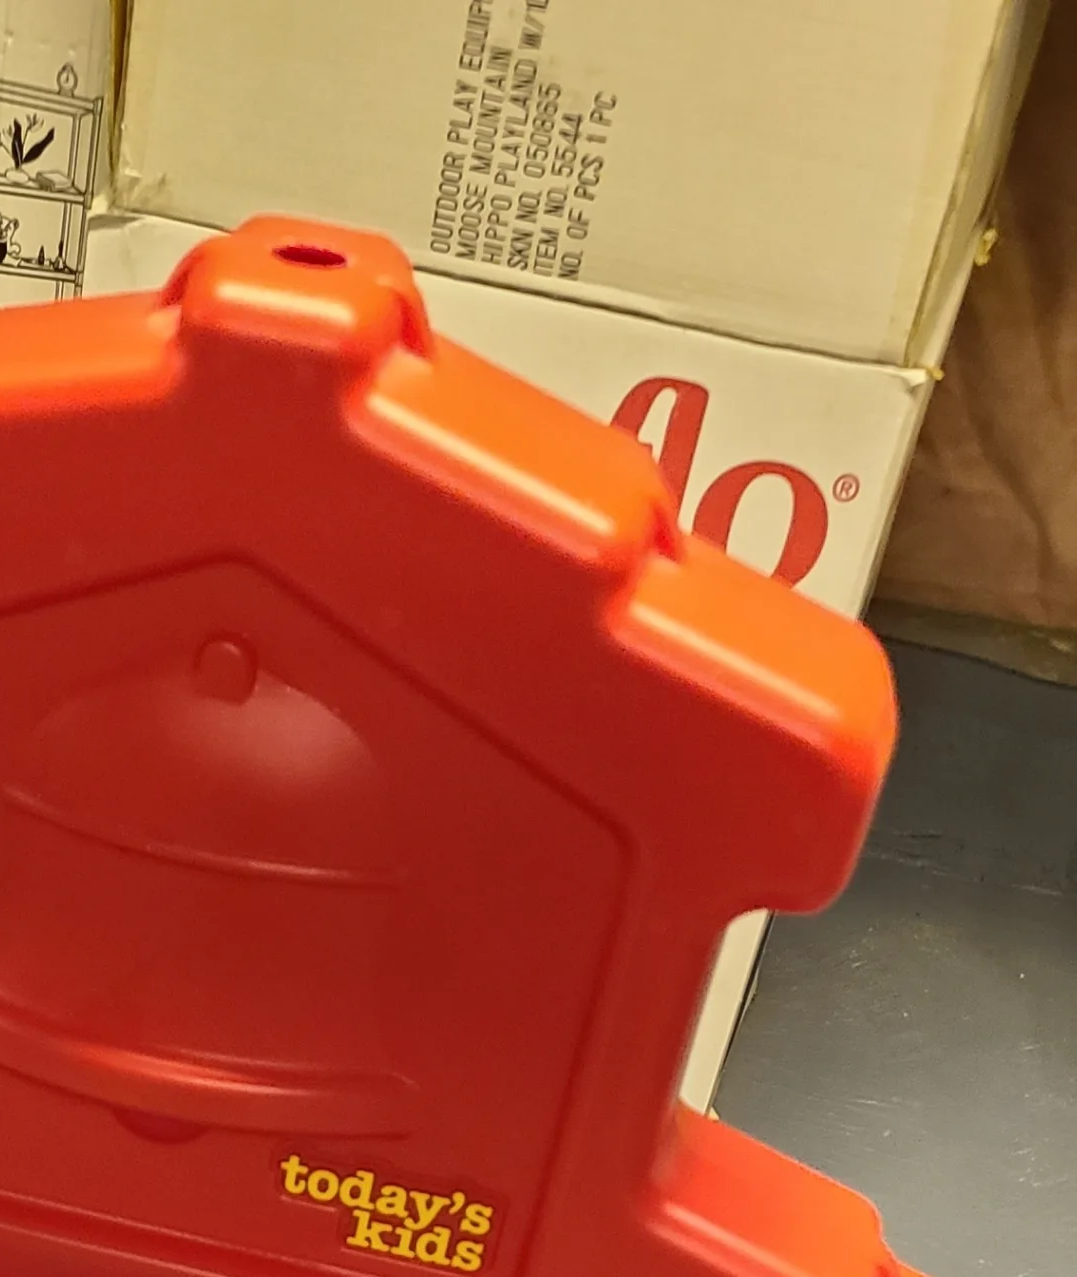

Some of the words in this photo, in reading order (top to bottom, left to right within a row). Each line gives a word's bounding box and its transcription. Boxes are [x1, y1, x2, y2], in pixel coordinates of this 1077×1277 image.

[447, 79, 478, 146] PLAY
[469, 45, 513, 175] MOUNTAIN
[493, 58, 538, 188] PLAYLAND
[523, 82, 562, 179] 050865
[589, 90, 618, 127] PC
[430, 151, 466, 254] OUTDOOR
[533, 227, 560, 277] ITEM
[551, 112, 584, 178] 5544
[573, 153, 605, 202] PCS
[455, 183, 488, 261] MOOSE
[480, 194, 513, 266] HIPPO
[566, 209, 591, 240] OF
[280, 1155, 493, 1235] today's
[346, 1209, 484, 1271] kids
